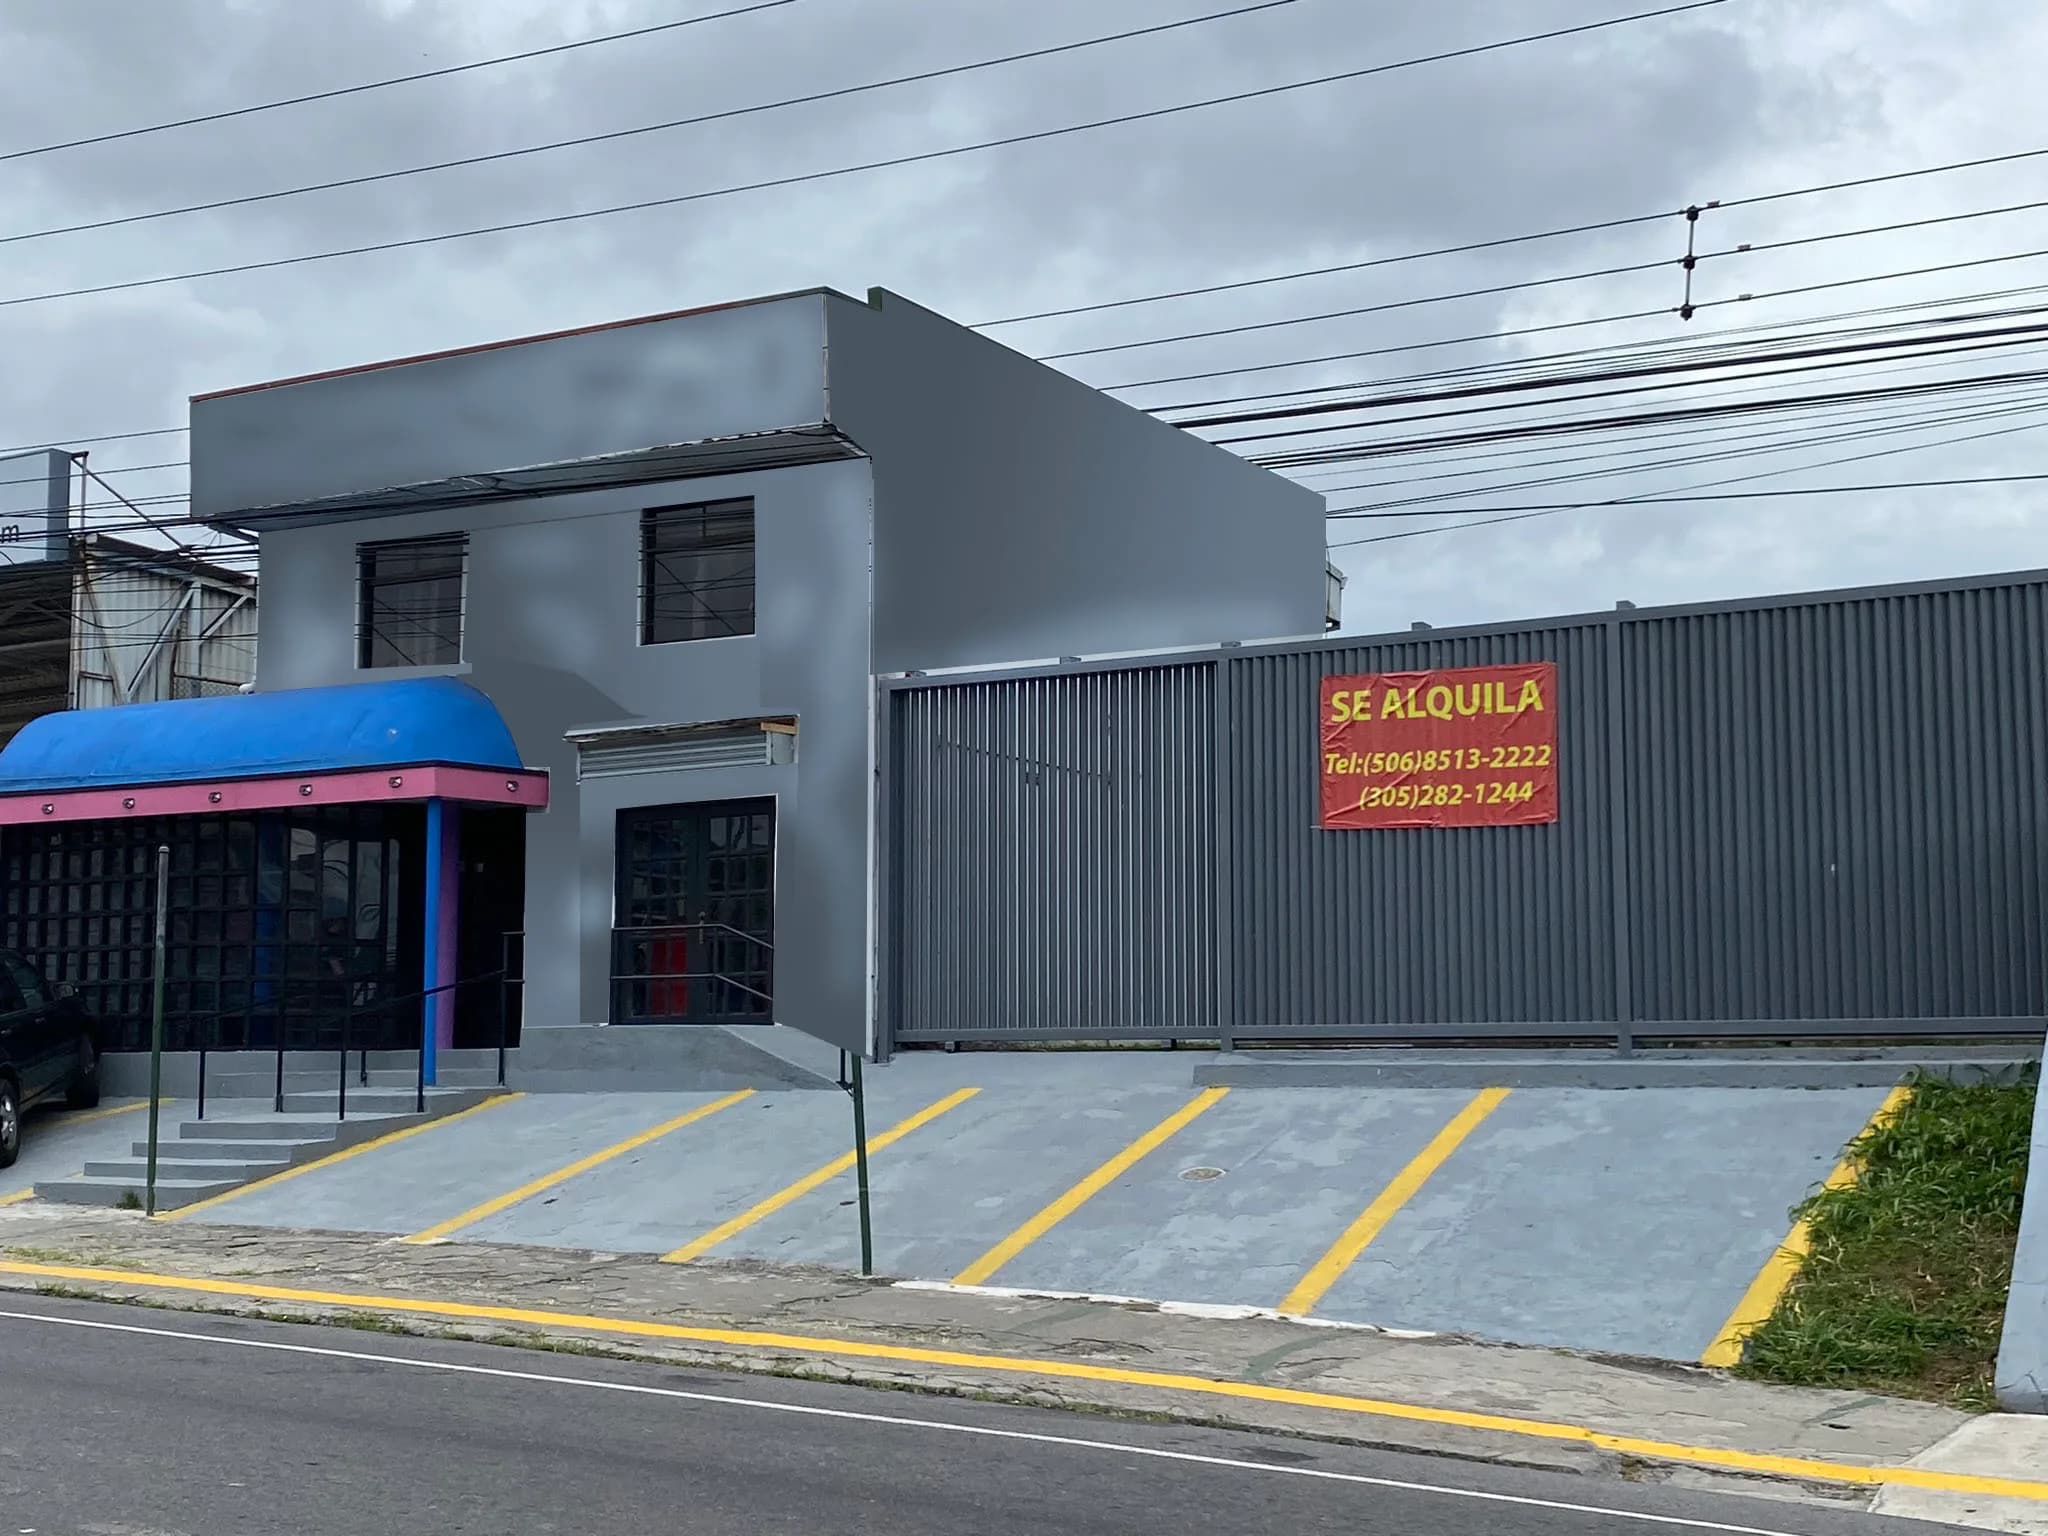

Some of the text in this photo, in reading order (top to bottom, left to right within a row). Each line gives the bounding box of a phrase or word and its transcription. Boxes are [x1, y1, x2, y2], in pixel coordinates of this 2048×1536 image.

[1331, 680, 1544, 722] SE ALQUILA
[1325, 745, 1551, 776] Tel:(506)8513-2222
[1360, 781, 1533, 810] (305)282-1244
